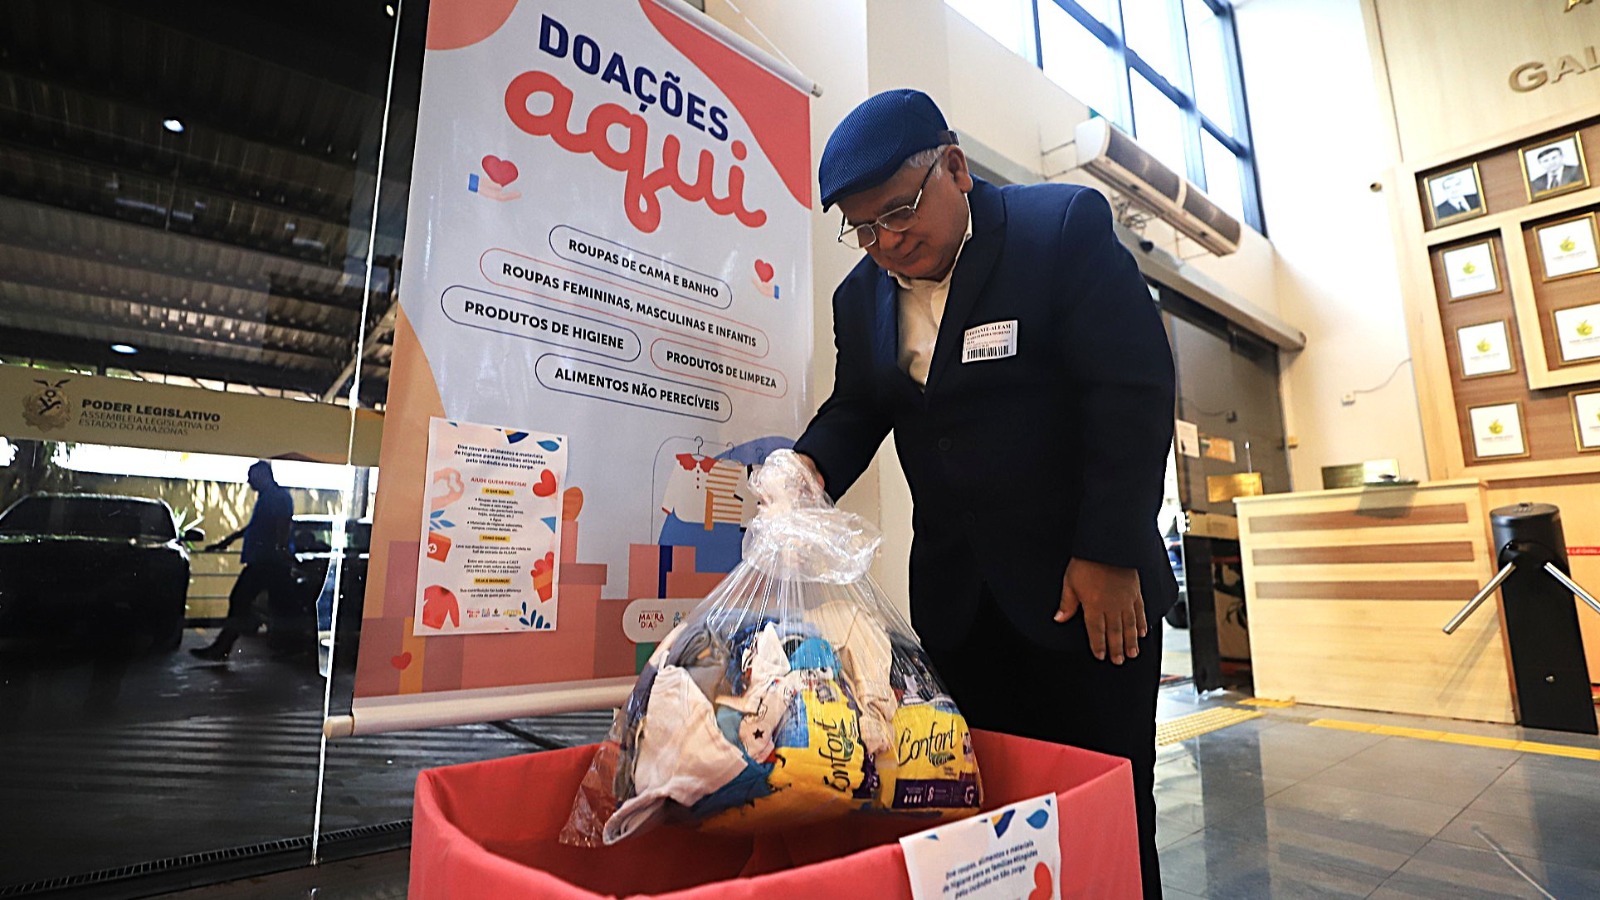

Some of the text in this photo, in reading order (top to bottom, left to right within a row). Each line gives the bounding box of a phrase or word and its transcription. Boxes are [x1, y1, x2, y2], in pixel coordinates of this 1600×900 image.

[539, 13, 728, 141] DOAÇÕES
[504, 70, 767, 233] aqui
[568, 239, 719, 299] ROUPAS DE CAMA E BANHO
[464, 300, 625, 350] PRODUTOS DE HIGIENE
[502, 262, 757, 348] ROUPAS FEMININAS, MASCULINAS E INFANTIS
[555, 366, 720, 412] ALIMENTOS NÃO PERECÍVEIS
[666, 350, 777, 389] PRODUTOS DE LIMPEZA
[79, 418, 188, 436] ESTADO DO AMAZONAS
[80, 411, 219, 432] ASSEMBLEIA LEGISLATIVA DO
[82, 399, 221, 423] PODER LEGISLATIVO
[899, 719, 955, 766] Confort
